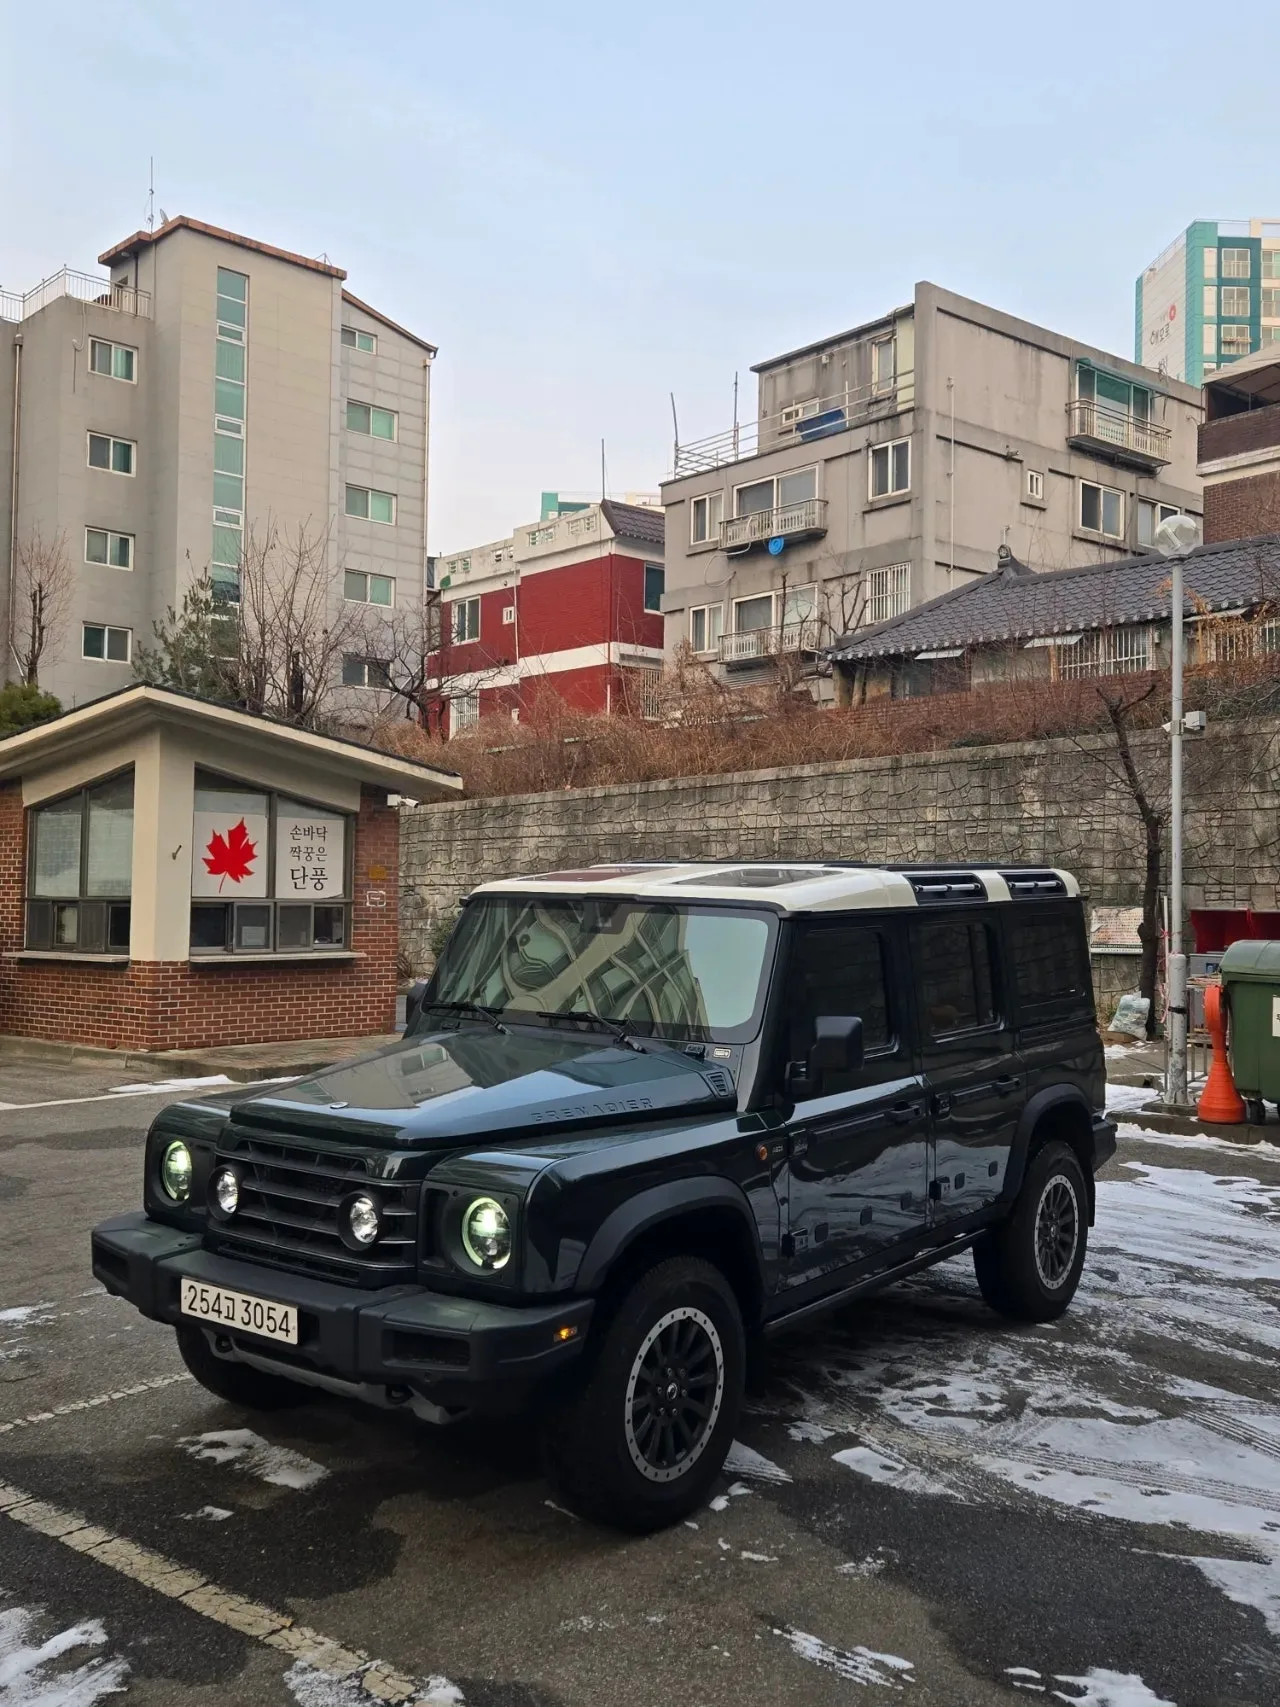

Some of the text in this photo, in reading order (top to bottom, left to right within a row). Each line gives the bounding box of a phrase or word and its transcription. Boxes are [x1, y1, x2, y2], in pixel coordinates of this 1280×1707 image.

[290, 825, 328, 842] 손바닥
[290, 846, 328, 862] 짝꿍은
[290, 866, 328, 891] 단풍
